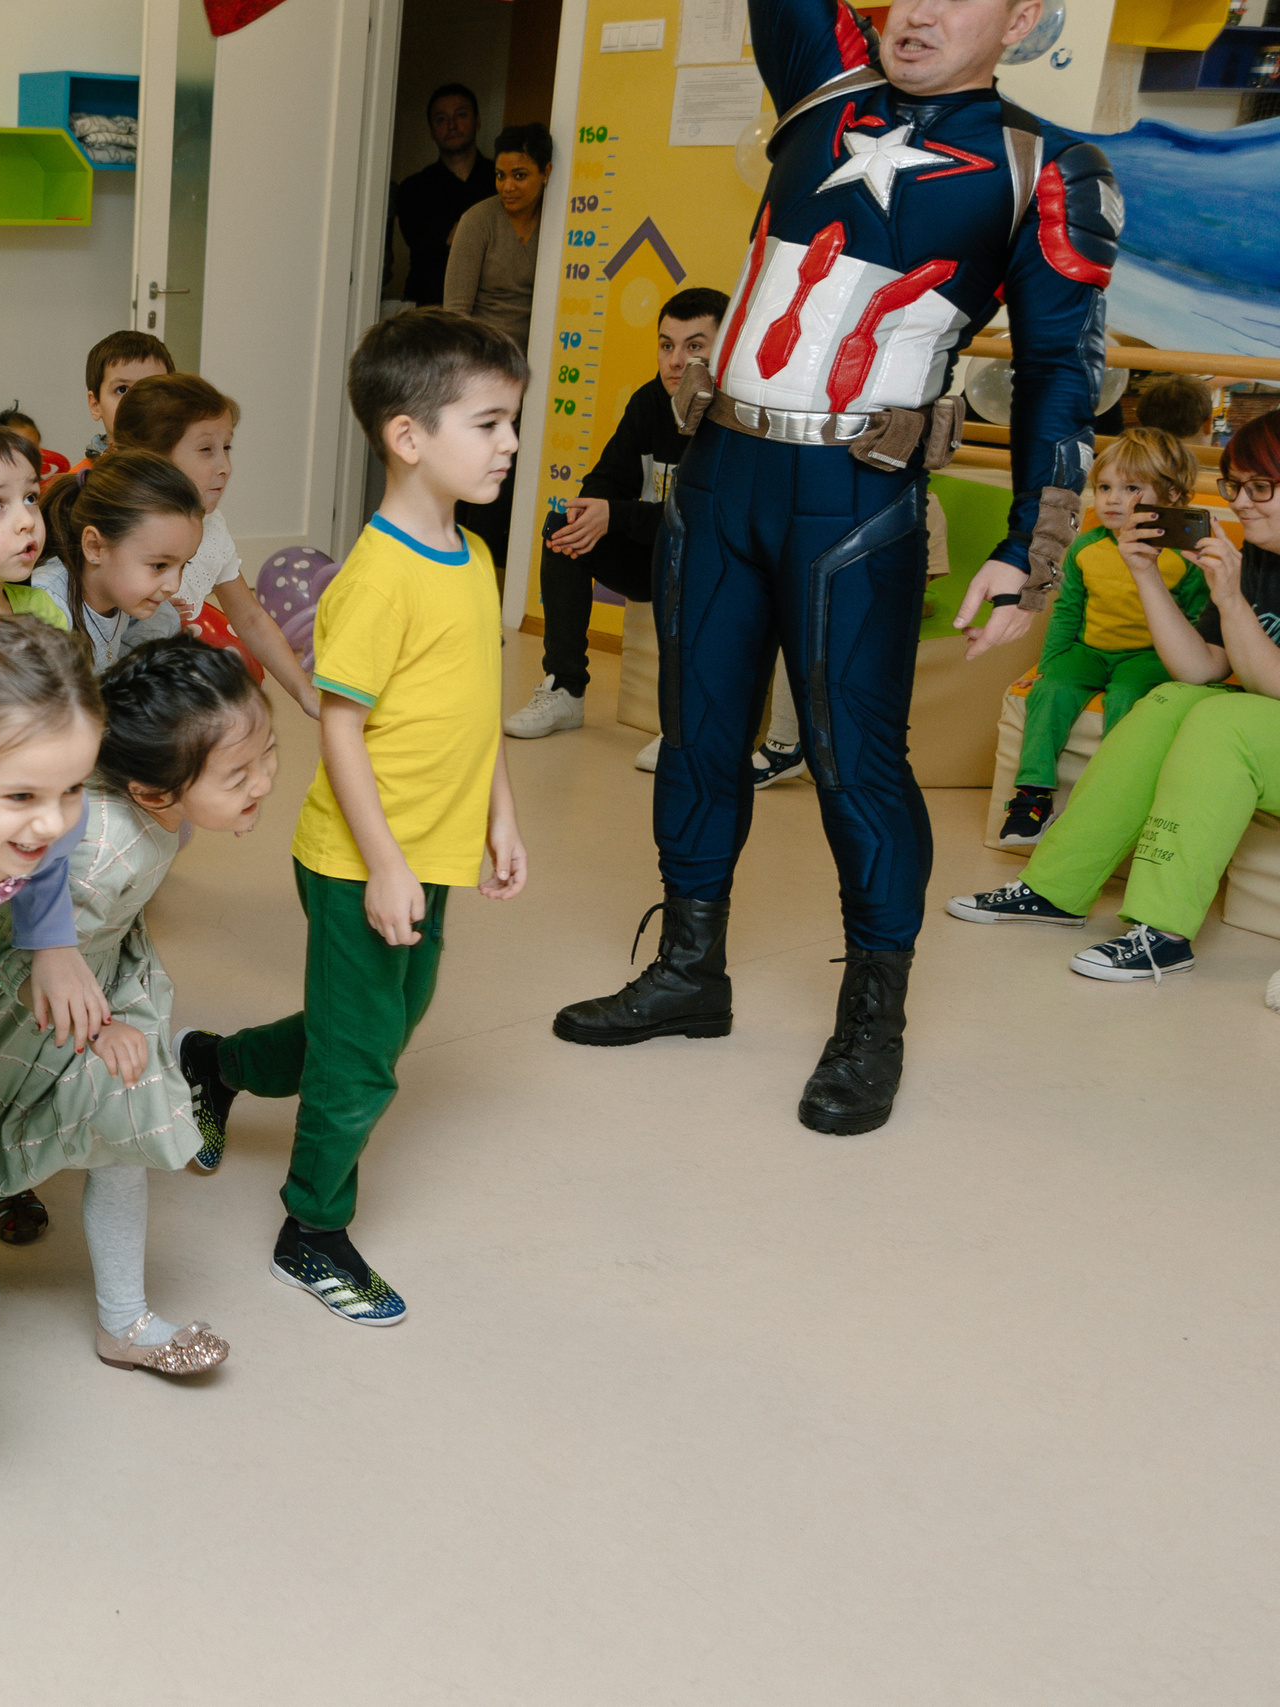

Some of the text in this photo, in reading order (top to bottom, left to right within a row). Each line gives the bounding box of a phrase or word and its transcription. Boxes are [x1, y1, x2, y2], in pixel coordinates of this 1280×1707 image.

[579, 125, 608, 144] 150
[570, 194, 599, 214] 130
[567, 229, 596, 247] 120
[565, 262, 590, 281] 110
[559, 331, 582, 350] 90
[558, 365, 580, 384] 80
[554, 398, 576, 416] 70
[550, 463, 571, 481] 50
[547, 496, 569, 514] 40
